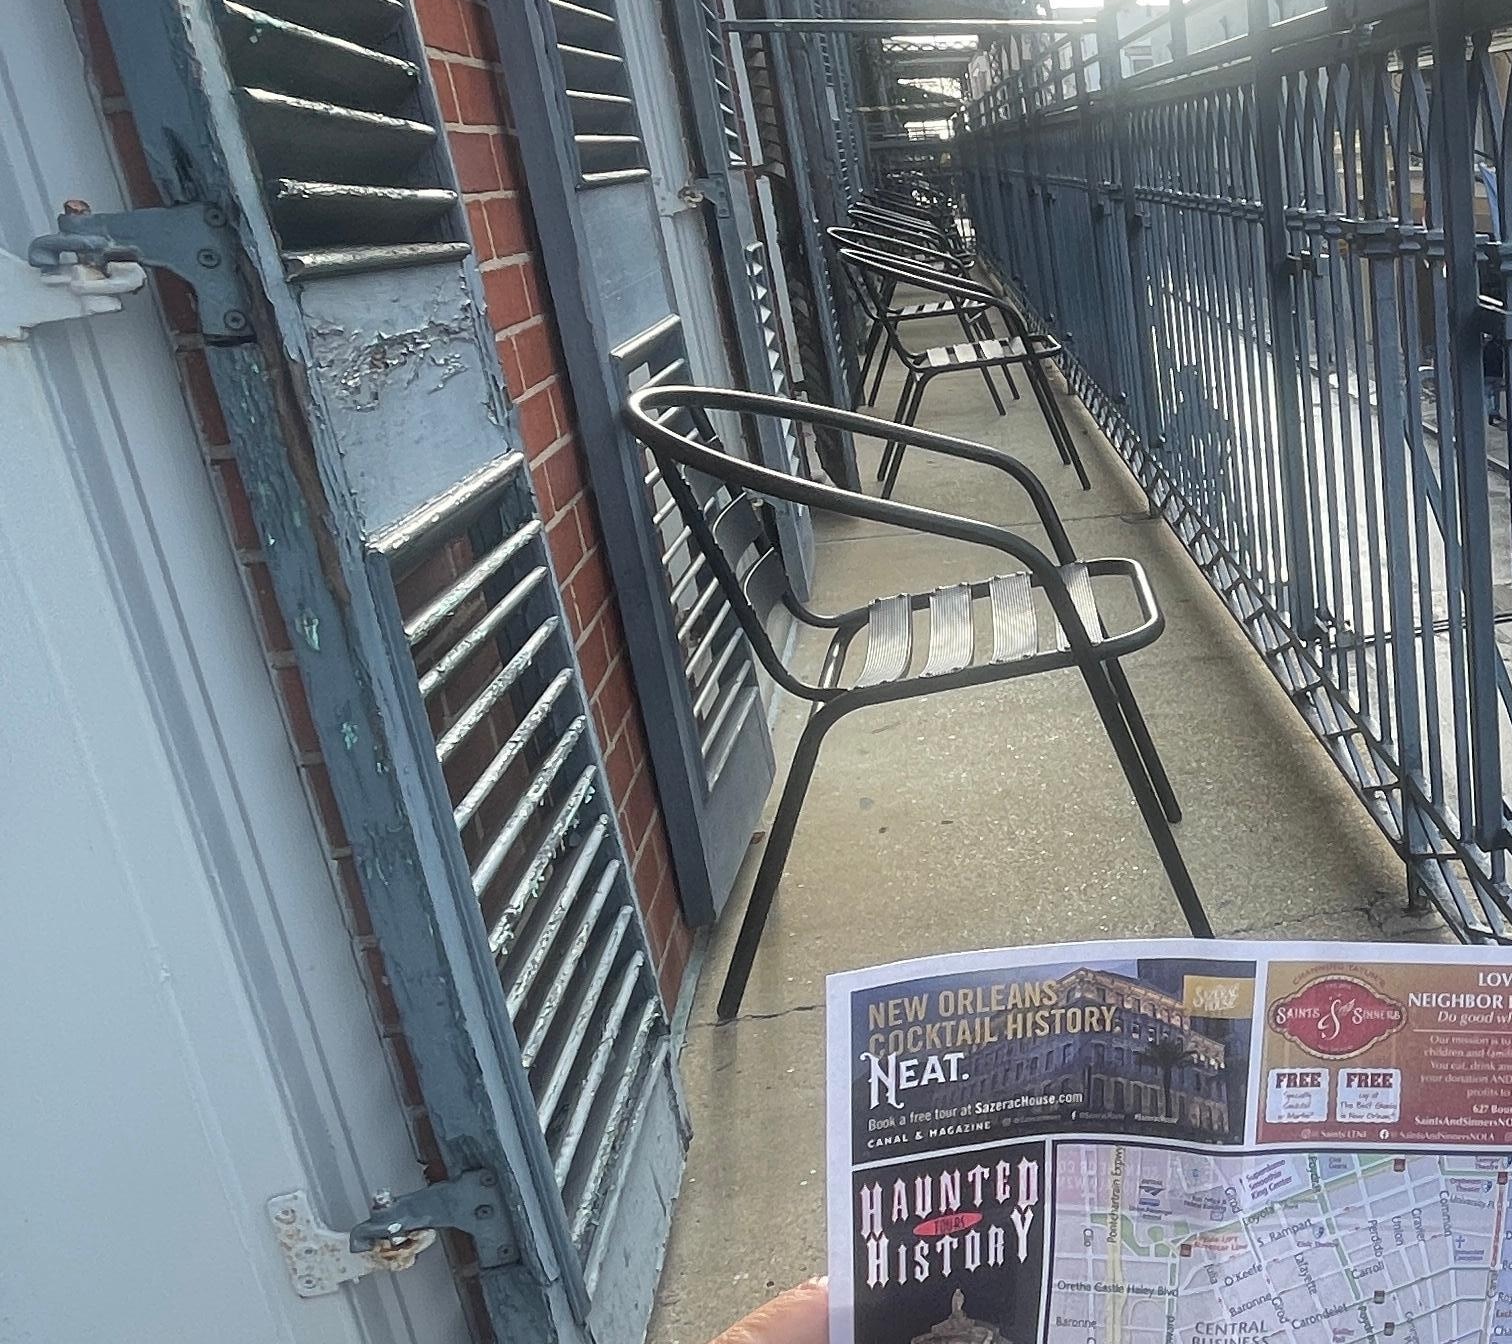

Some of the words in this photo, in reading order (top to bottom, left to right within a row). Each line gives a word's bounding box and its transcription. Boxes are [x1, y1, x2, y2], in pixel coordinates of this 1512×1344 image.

[868, 993, 927, 1031] NEW
[938, 980, 1058, 1018] ORLEANS
[1408, 992, 1504, 1010] NEIGHBOR
[1275, 1006, 1320, 1025] SAINTS
[1351, 1006, 1401, 1025] SINNERS
[1438, 1011, 1456, 1023] Do
[1459, 1012, 1494, 1027] good
[868, 1021, 998, 1056] COCKTAIL
[1007, 1006, 1121, 1040] HISTORY.
[860, 1052, 970, 1109] NEAT.
[1275, 1072, 1321, 1088] FREE
[1346, 1072, 1393, 1089] FREE
[867, 1116, 896, 1132] Book
[900, 1116, 906, 1125] a
[909, 1111, 930, 1124] free
[934, 1106, 958, 1122] tour
[960, 1105, 972, 1116] at
[975, 1092, 1084, 1114] SazeracHouse.com
[867, 1134, 909, 1148] CANAL
[915, 1131, 924, 1140] &
[929, 1121, 991, 1138] MAGAZINE
[860, 1156, 1040, 1239] HAUNTED
[865, 1207, 1034, 1290] HISTORY
[1195, 1319, 1269, 1335] CENTRAL
